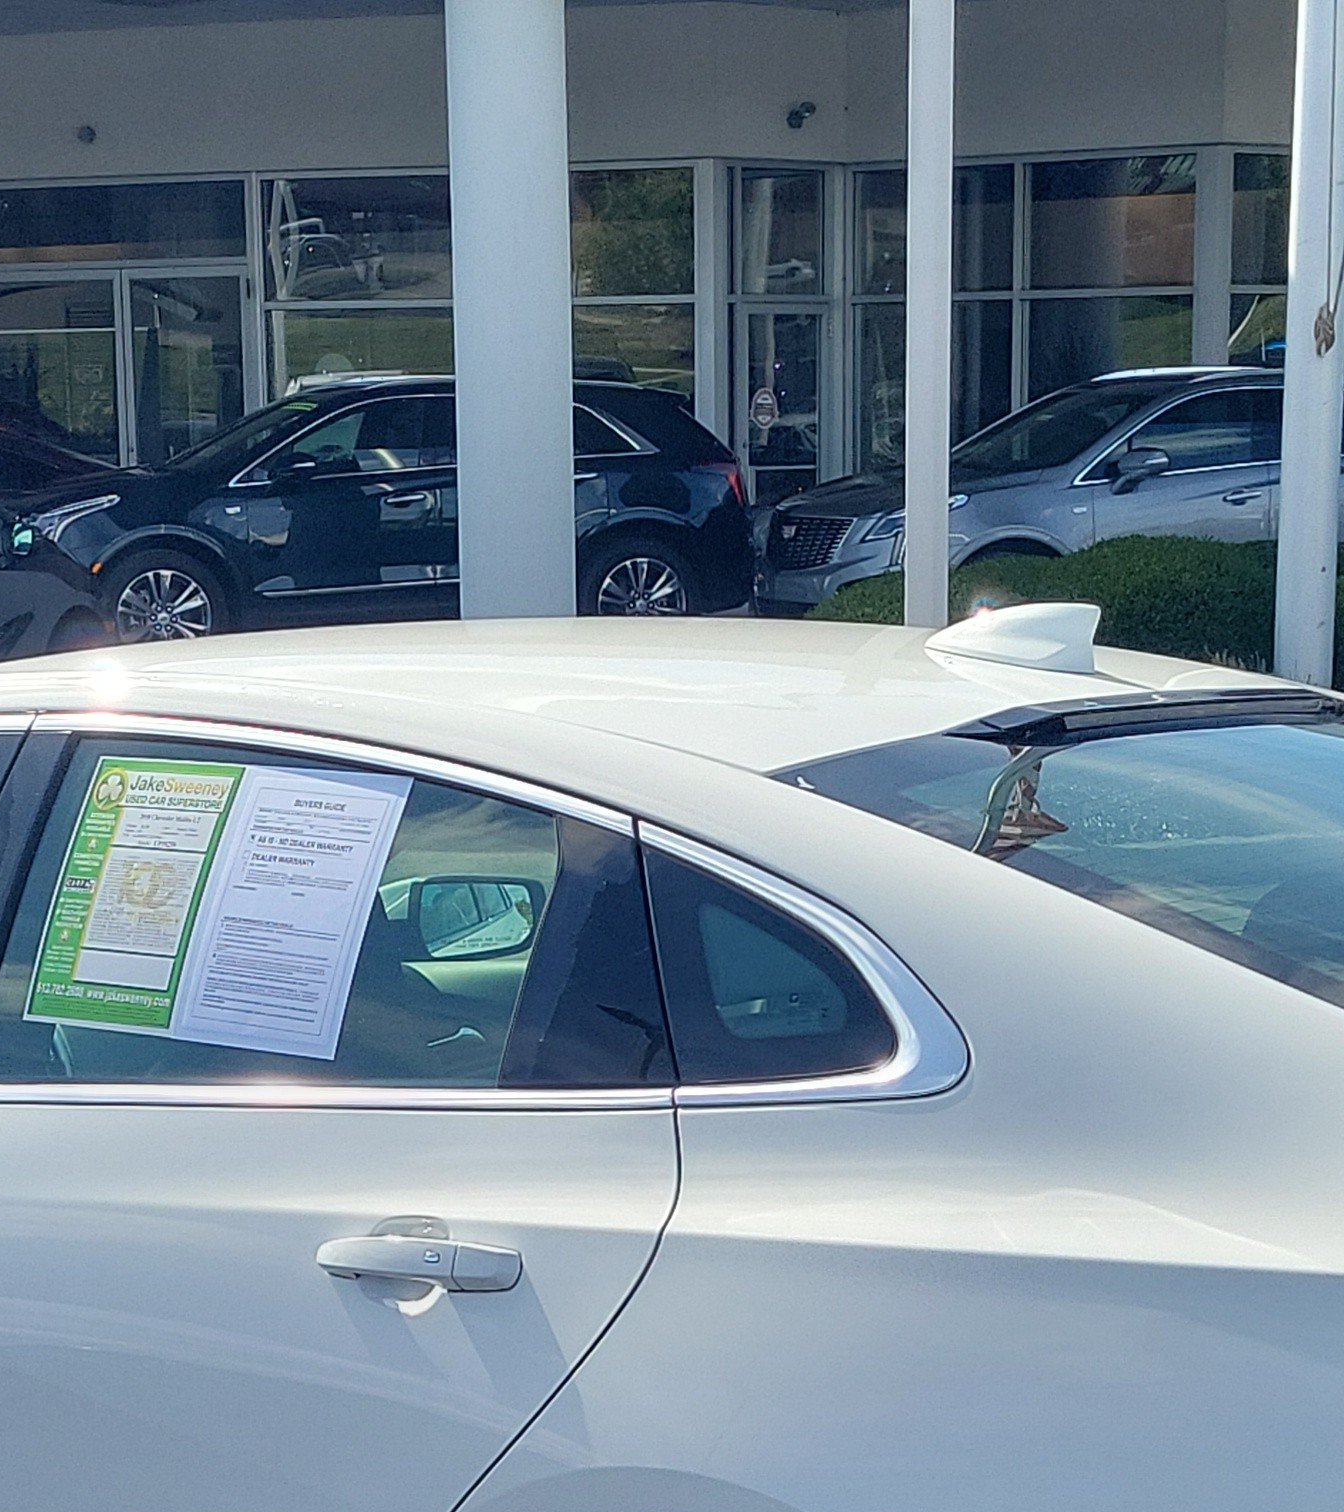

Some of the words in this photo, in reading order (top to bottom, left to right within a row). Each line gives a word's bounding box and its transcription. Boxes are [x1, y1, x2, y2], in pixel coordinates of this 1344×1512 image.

[130, 775, 230, 799] JakeSweeney
[148, 796, 166, 806] CAR
[324, 802, 347, 812] GUIDE
[289, 838, 316, 849] DEALER
[316, 842, 354, 853] WARRANTY
[251, 852, 278, 863] DEALER
[278, 856, 315, 867] WARRANTY
